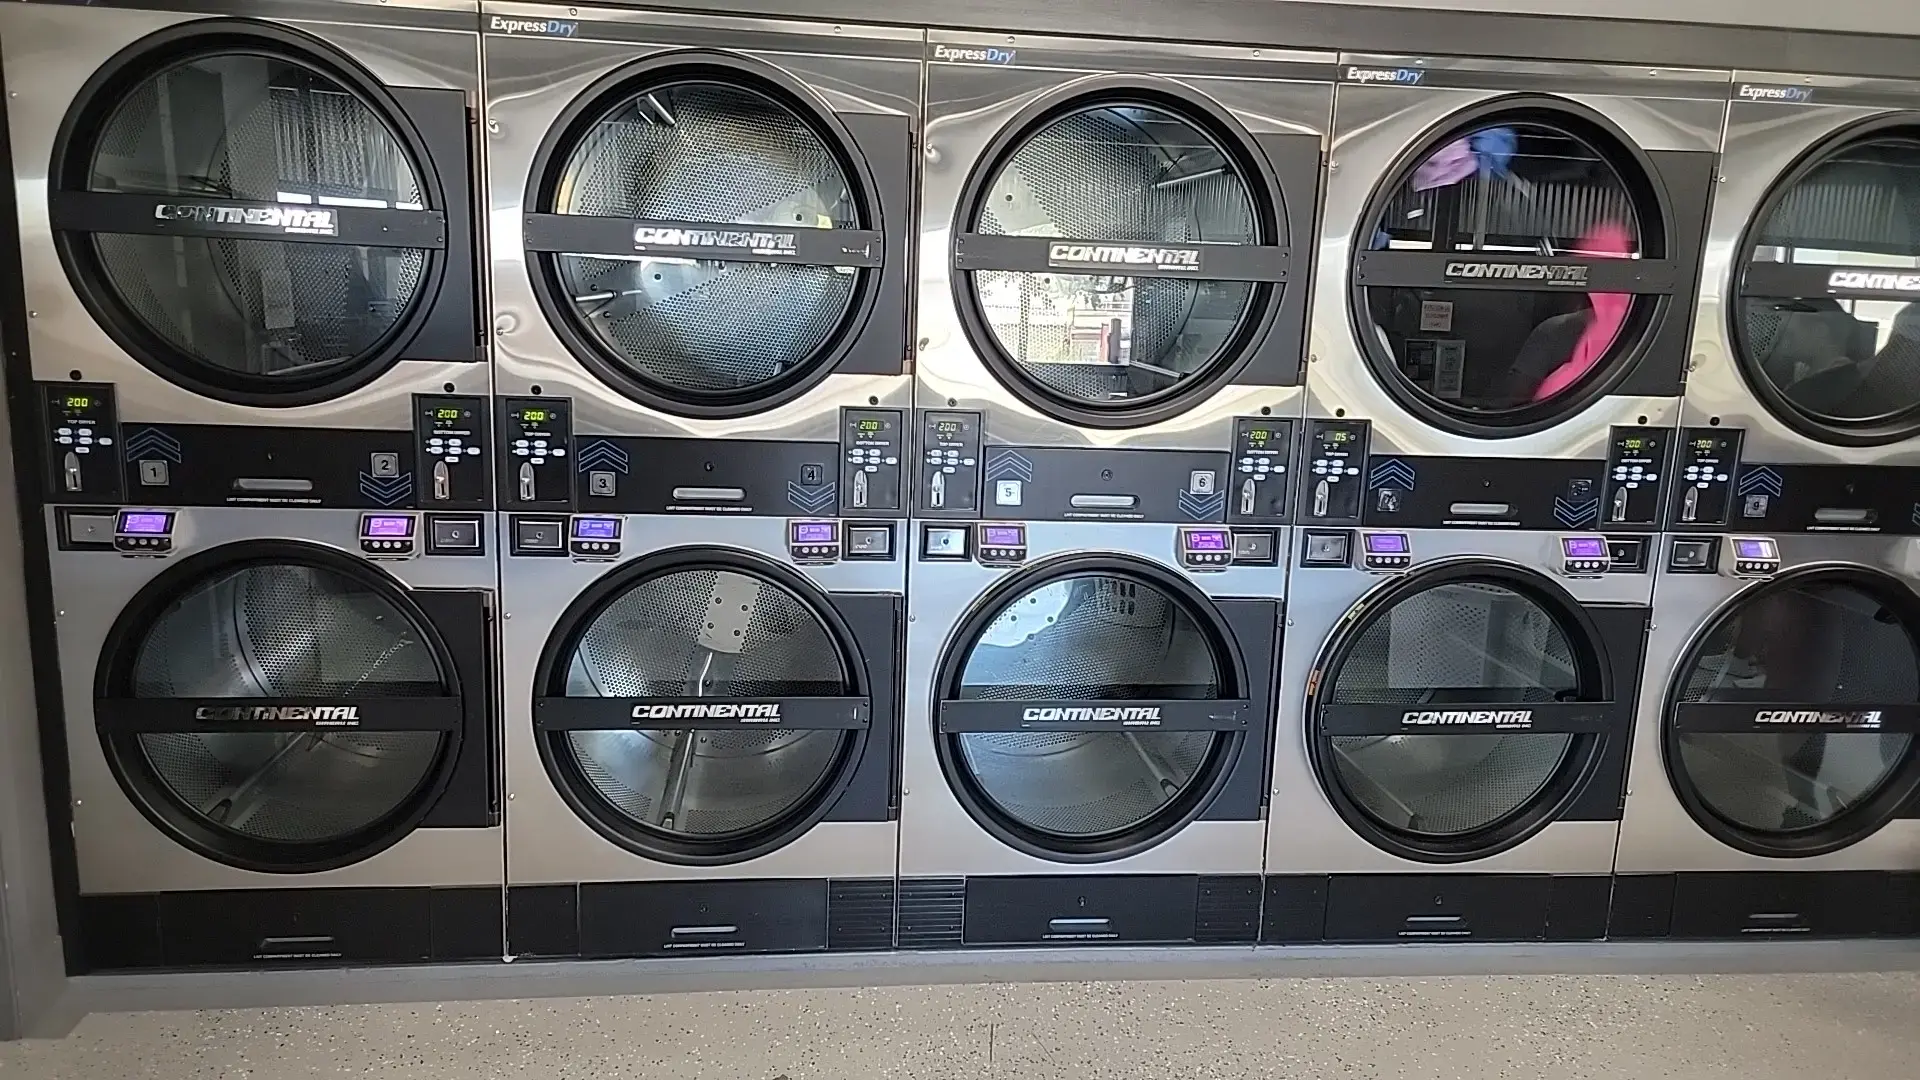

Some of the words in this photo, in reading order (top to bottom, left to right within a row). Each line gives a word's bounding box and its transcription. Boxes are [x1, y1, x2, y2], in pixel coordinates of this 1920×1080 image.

[490, 16, 577, 37] ExpressDry
[935, 45, 1015, 64] ExpressDry
[1347, 67, 1424, 84] ExpressDry
[1740, 85, 1812, 102] ExpressDry
[635, 228, 796, 249] CONTINENTAL
[1050, 245, 1199, 265] CONTINENTAL
[1446, 263, 1588, 280] CONTINENTAL
[67, 398, 88, 407] 200
[437, 410, 457, 418] 200
[523, 411, 544, 420] 200
[860, 421, 878, 430] 200
[938, 422, 956, 431] 200
[1250, 431, 1268, 439] 200
[381, 460, 389, 470] 2
[150, 468, 157, 478] 1
[808, 470, 815, 480] 4
[600, 479, 607, 488] 3
[1200, 478, 1206, 487] 6
[1005, 488, 1012, 497] 5
[196, 706, 359, 720] CONTINENTAL
[632, 704, 780, 718] CONTINENTAL
[1023, 708, 1161, 721] CONTINENTAL
[1402, 711, 1533, 724] CONTINENTAL
[1755, 711, 1882, 723] CONTINENTAL
